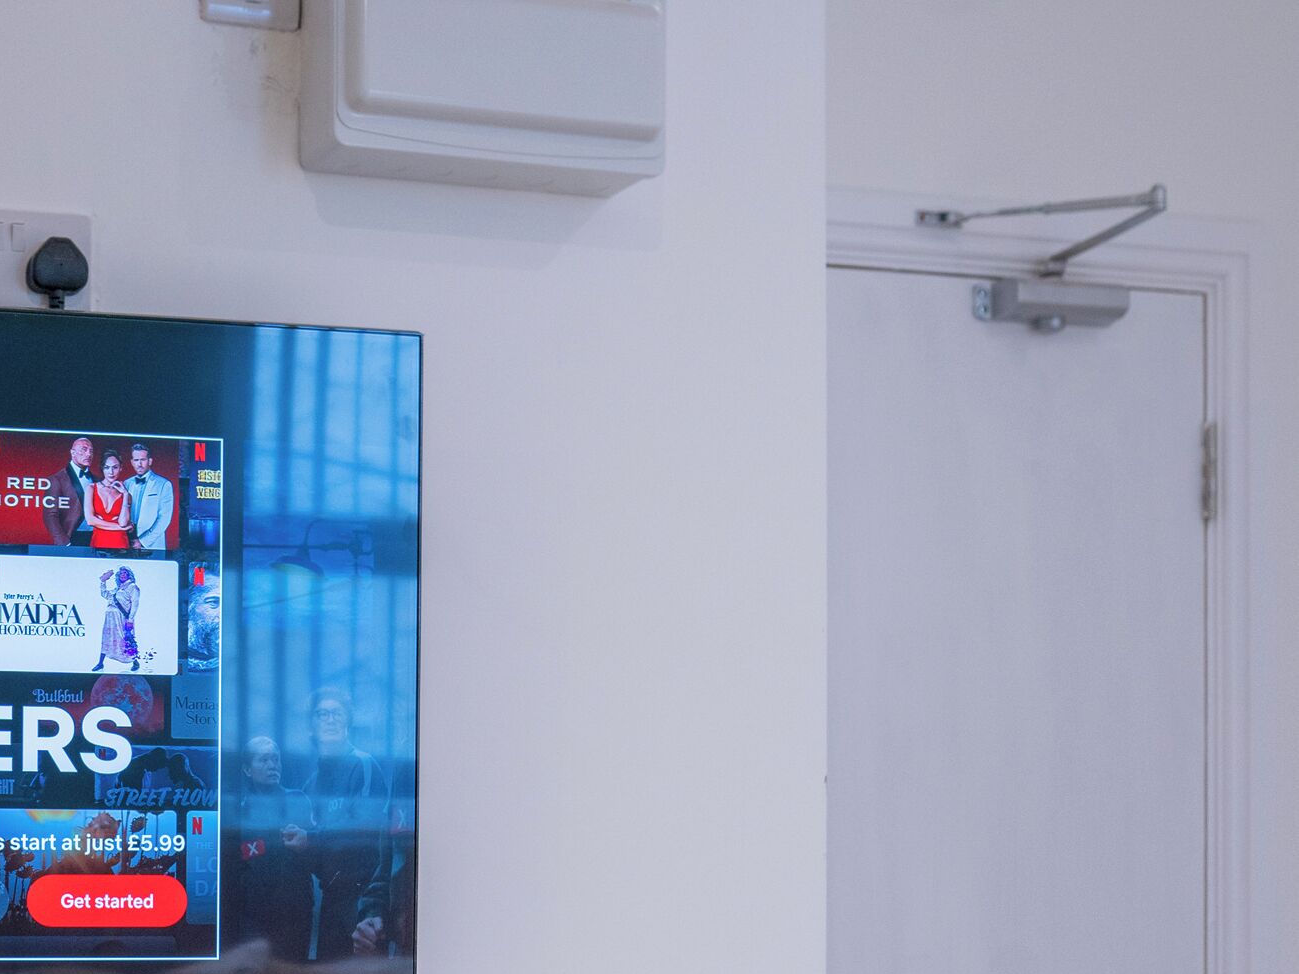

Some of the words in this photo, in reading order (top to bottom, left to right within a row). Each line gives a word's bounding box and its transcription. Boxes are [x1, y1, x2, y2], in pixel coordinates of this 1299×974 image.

[6, 476, 51, 490] RED
[104, 787, 172, 807] STREET
[10, 834, 57, 851] start
[61, 835, 81, 851] at
[84, 834, 122, 855] just
[127, 834, 186, 852] £5.99
[60, 893, 91, 909] Get
[94, 892, 154, 909] started
